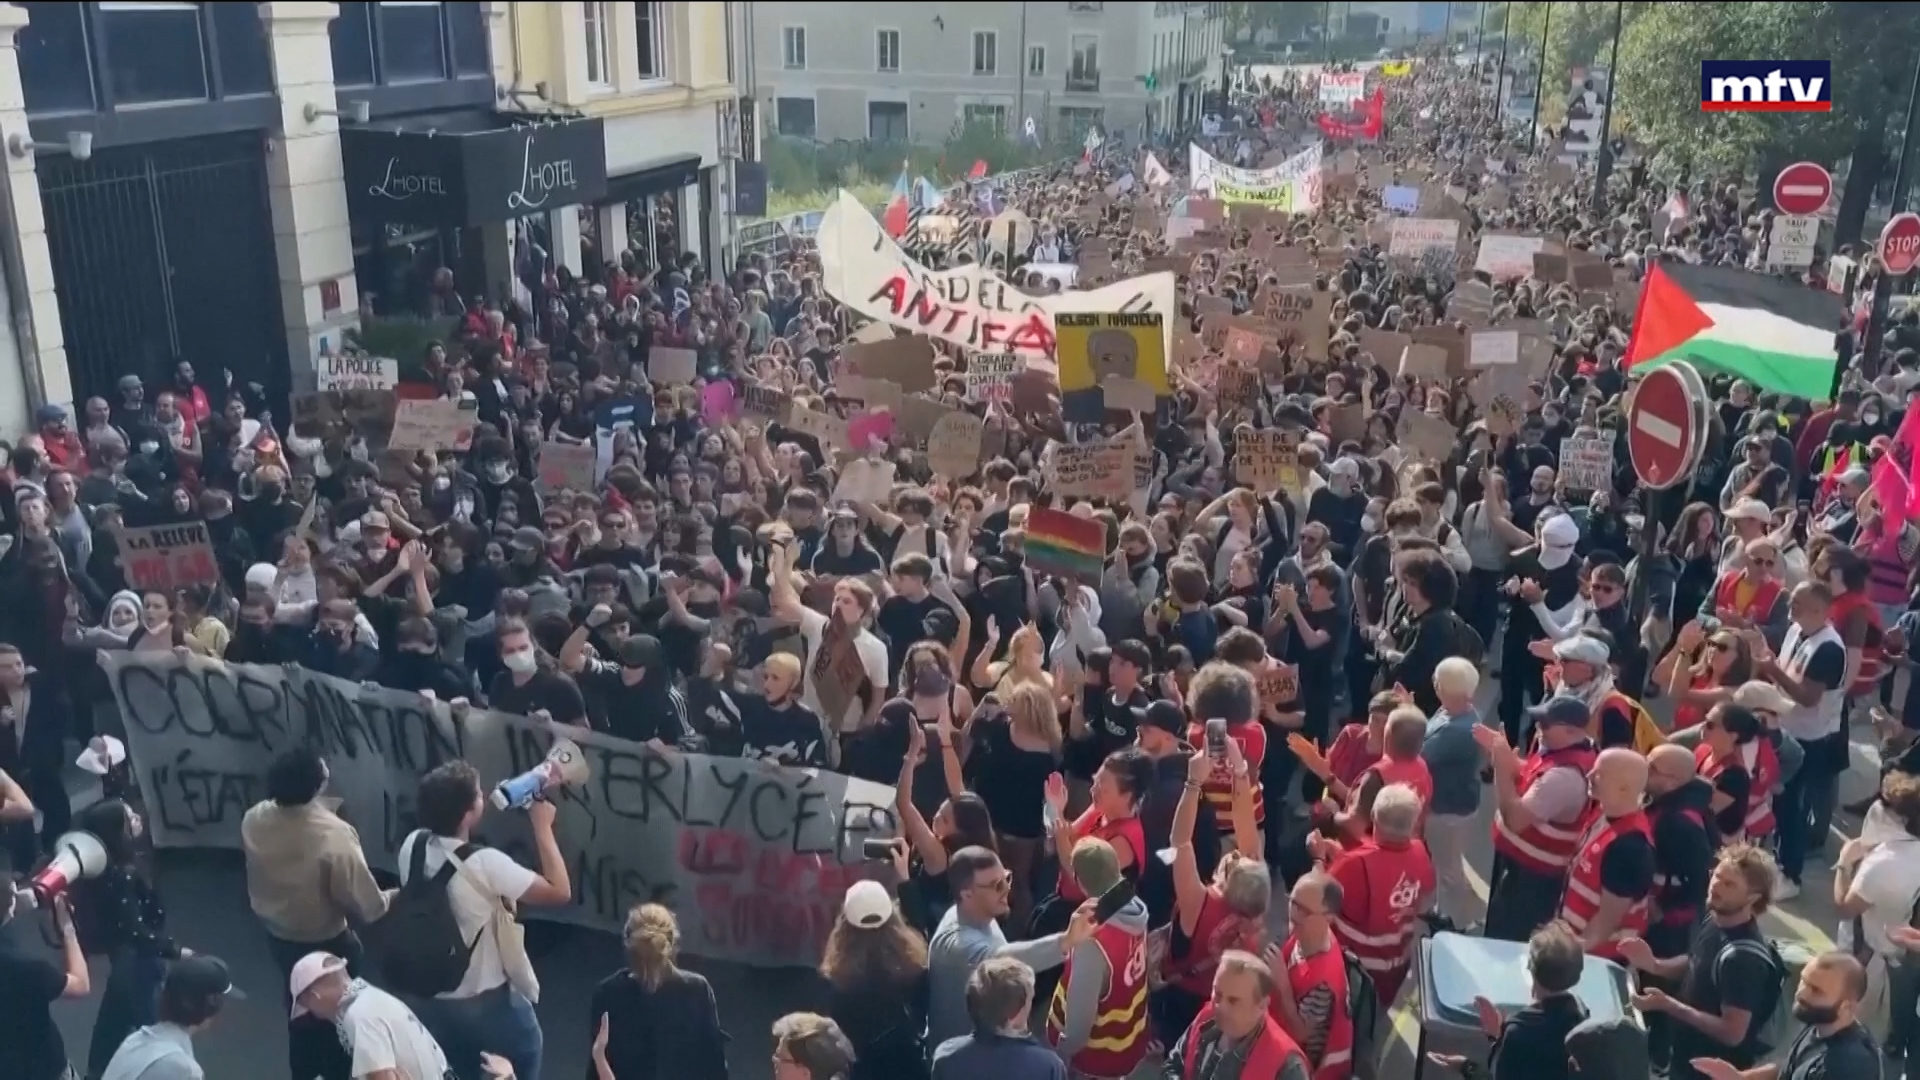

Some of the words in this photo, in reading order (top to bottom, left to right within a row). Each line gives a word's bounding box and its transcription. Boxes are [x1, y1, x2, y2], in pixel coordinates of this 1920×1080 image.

[1886, 235, 1920, 254] STOP
[868, 276, 1057, 363] ANTIFA
[328, 359, 343, 375] LA
[346, 359, 383, 376] POLICE
